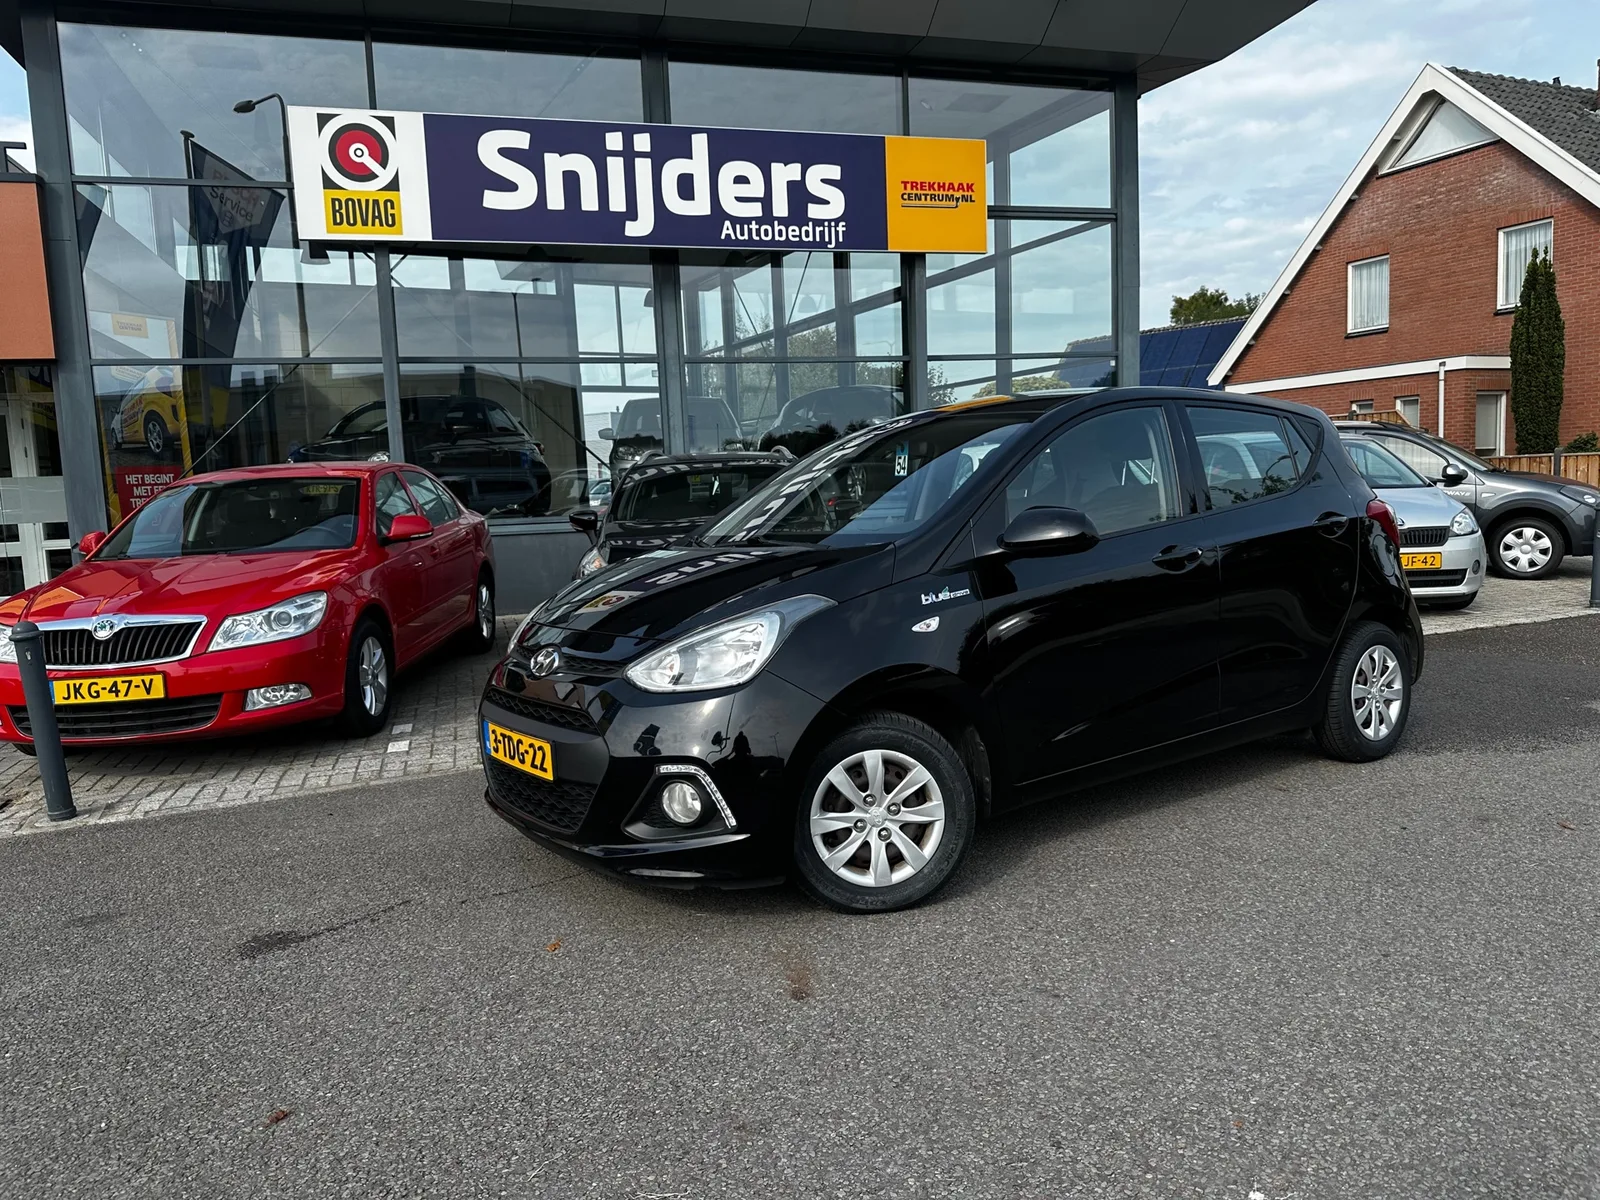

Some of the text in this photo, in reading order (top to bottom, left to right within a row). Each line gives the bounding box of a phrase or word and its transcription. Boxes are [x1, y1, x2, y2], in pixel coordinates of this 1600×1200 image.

[477, 129, 846, 237] Snijders
[901, 180, 975, 193] TREKHAAK
[209, 186, 254, 222] Service
[330, 197, 397, 228] BOVAG
[720, 219, 847, 248] Autobedrijf
[896, 455, 907, 475] 54
[125, 473, 175, 485] HET BEGINT
[133, 486, 153, 497] MET
[920, 586, 951, 605] blue
[62, 678, 154, 701] JKG-47-V
[491, 728, 548, 773] 3-TDG-22
